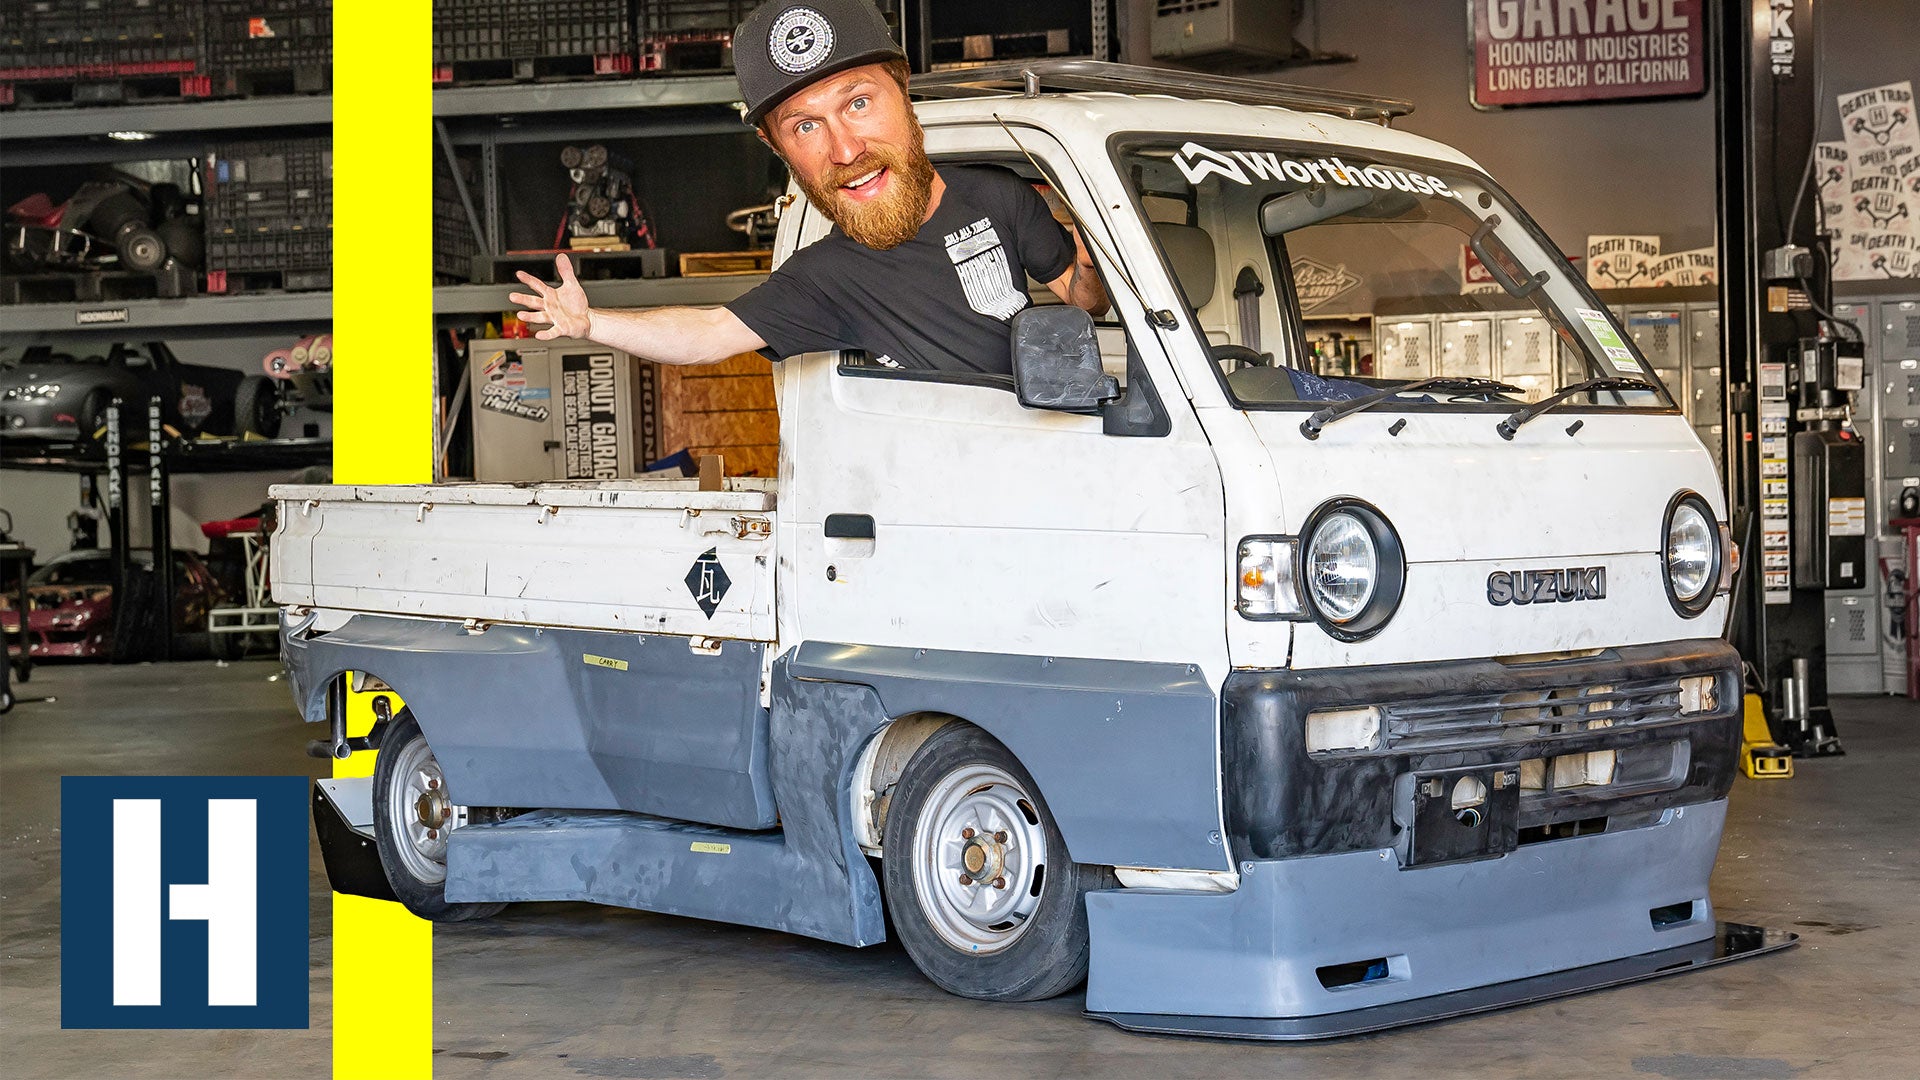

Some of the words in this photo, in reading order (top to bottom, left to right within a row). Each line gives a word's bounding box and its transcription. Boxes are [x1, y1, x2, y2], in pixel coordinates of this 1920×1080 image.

[1488, 0, 1690, 40] GARAGE
[1488, 39, 1577, 67] HOONIGAN
[1585, 33, 1690, 62] INDUSTRIES
[1488, 67, 1531, 92] LONG
[1534, 64, 1587, 89] BEACH
[1594, 59, 1690, 86] CALIFORNIA
[1841, 91, 1877, 117] DEATH
[1880, 89, 1910, 103] TRAP
[1819, 145, 1847, 161] TRAP
[1851, 176, 1889, 193] DEATH
[1589, 239, 1626, 257] DEATH
[1629, 238, 1658, 257] TRAP
[1868, 234, 1907, 250] DEATH
[1650, 259, 1686, 281] DEATH
[563, 371, 576, 395] LONG
[576, 370, 591, 419] HOONIGAN
[589, 355, 615, 415] DONUT
[565, 396, 578, 425] BEACH
[106, 407, 121, 494] BENDPAK
[149, 406, 161, 491] BENDPAK
[566, 427, 580, 478] CALIFORNIA
[578, 421, 593, 478] INDUSTRIES
[591, 421, 618, 480] GARAG
[1487, 566, 1606, 606] SUZUKI
[598, 657, 619, 668] CARRY
